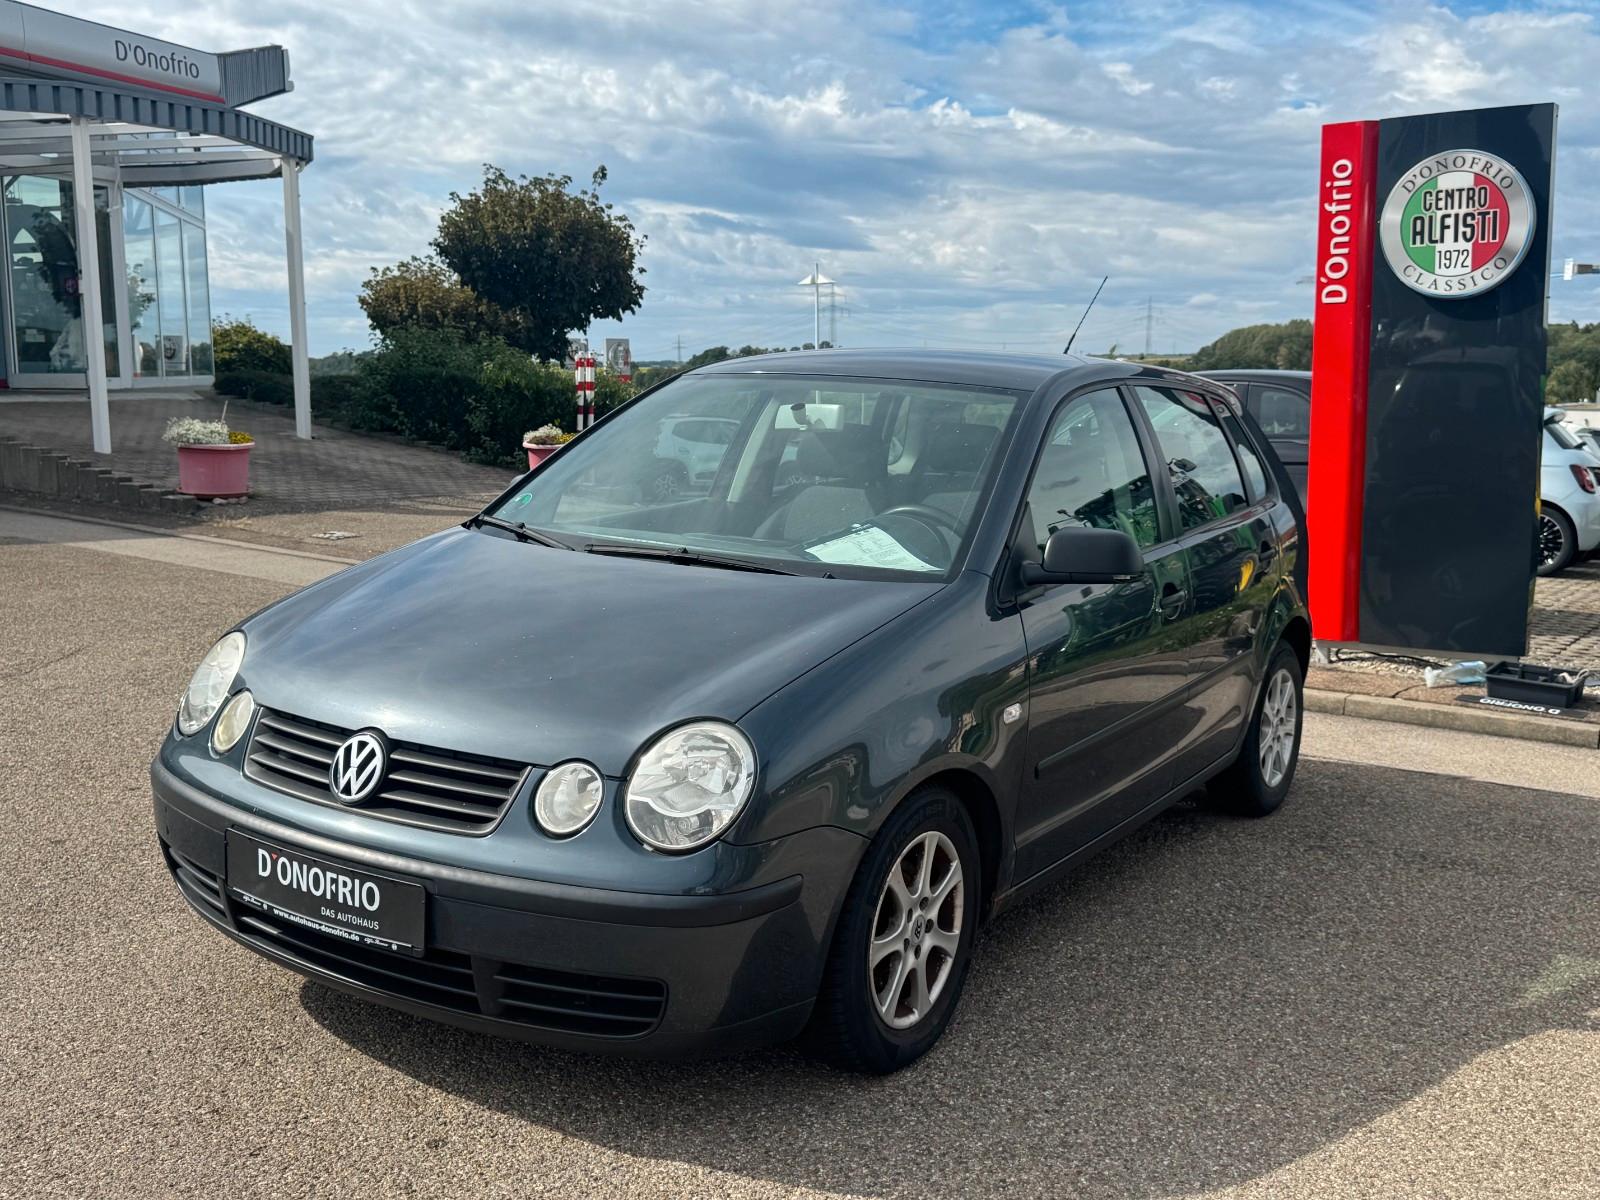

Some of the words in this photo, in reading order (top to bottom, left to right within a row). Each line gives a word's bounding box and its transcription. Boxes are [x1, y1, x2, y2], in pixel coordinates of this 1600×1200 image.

[115, 40, 199, 78] D'Onofrio
[1402, 155, 1514, 195] D'ONOFRIO
[1423, 186, 1488, 212] CENTRO
[1411, 210, 1499, 246] ALFISTI
[1403, 256, 1508, 292] CLASSICO
[1437, 249, 1470, 269] 1972
[273, 907, 360, 942] www.autohaus-donofrio.de
[320, 906, 336, 919] DAS
[337, 911, 380, 931] AUTOHAUS
